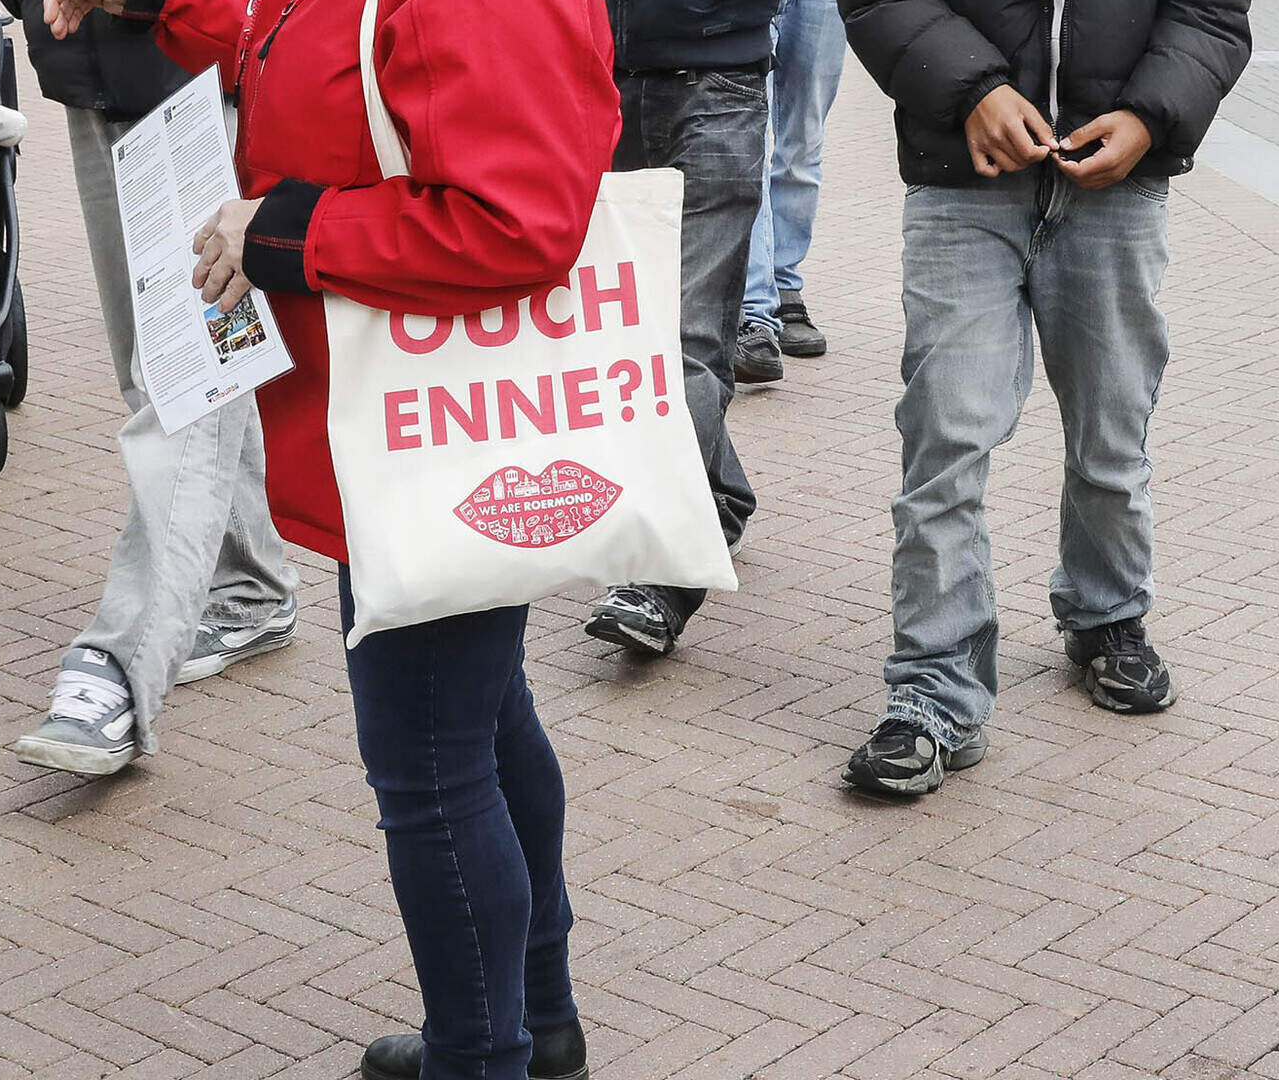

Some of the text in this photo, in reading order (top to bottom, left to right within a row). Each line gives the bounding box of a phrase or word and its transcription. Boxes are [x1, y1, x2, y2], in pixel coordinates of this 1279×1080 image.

[384, 354, 670, 452] ENNE?!
[478, 492, 593, 517] WE ARE ROERMOND
